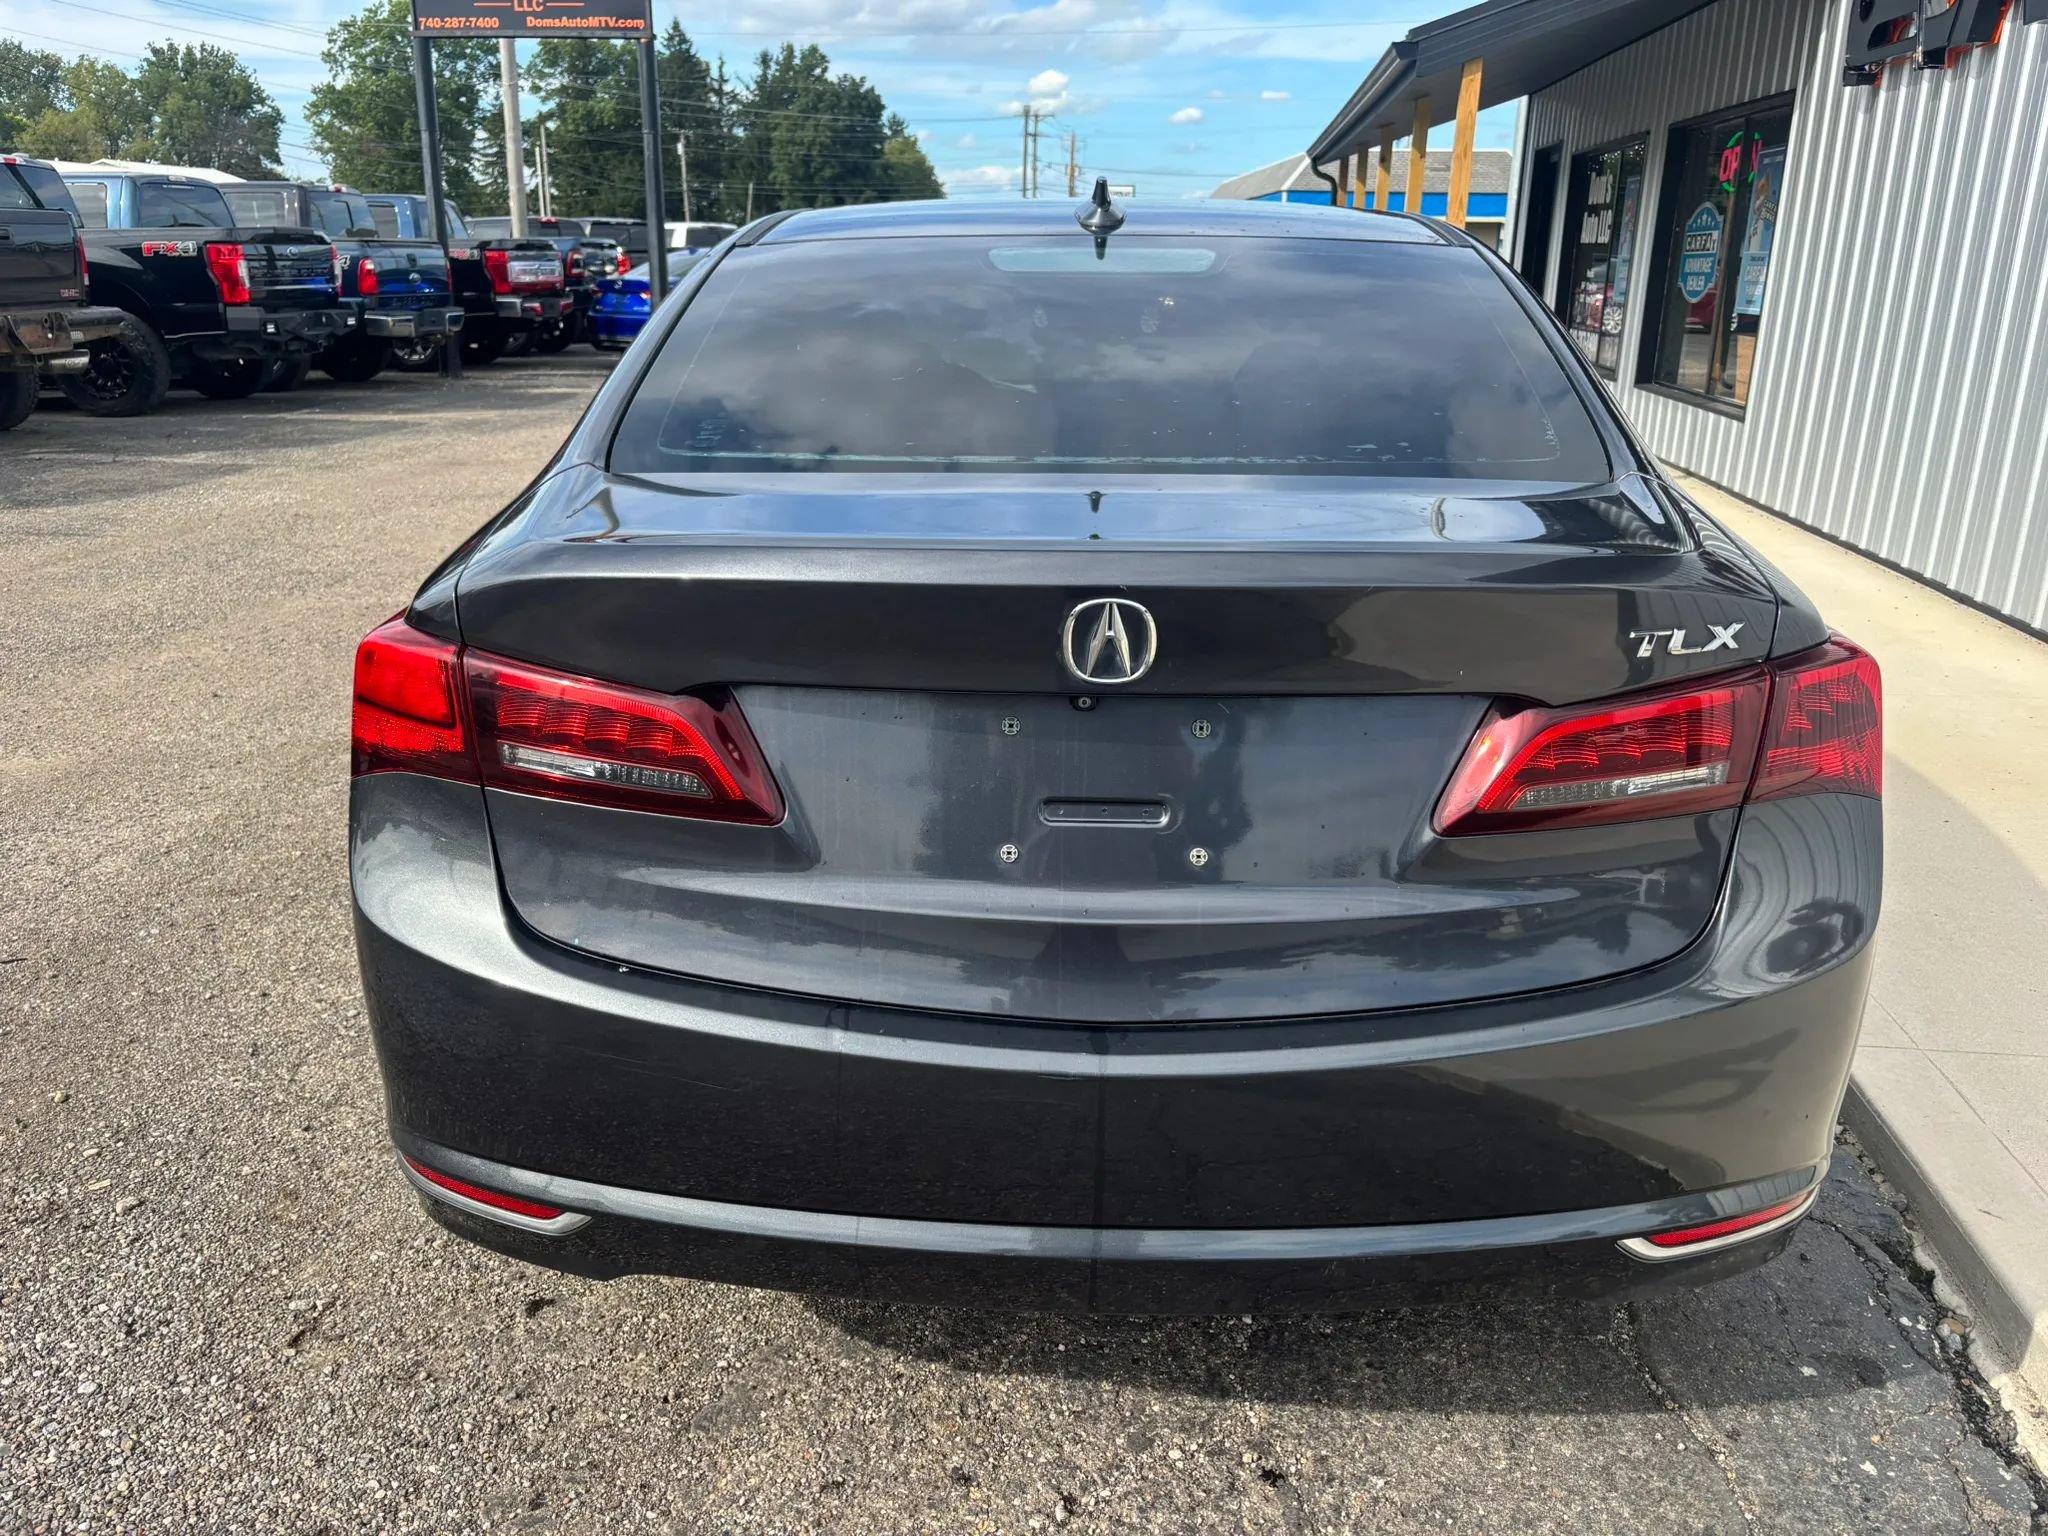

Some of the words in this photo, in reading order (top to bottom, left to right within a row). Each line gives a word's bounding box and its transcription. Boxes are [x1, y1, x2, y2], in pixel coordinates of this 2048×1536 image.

[514, 0, 544, 12] LLC
[418, 17, 500, 29] 740-287-7400
[526, 16, 646, 30] DomsAutoMTV.com
[1719, 140, 1763, 182] OPN
[1597, 209, 1613, 244] LLC
[142, 241, 198, 257] FX4
[1629, 622, 1745, 658] TLX
